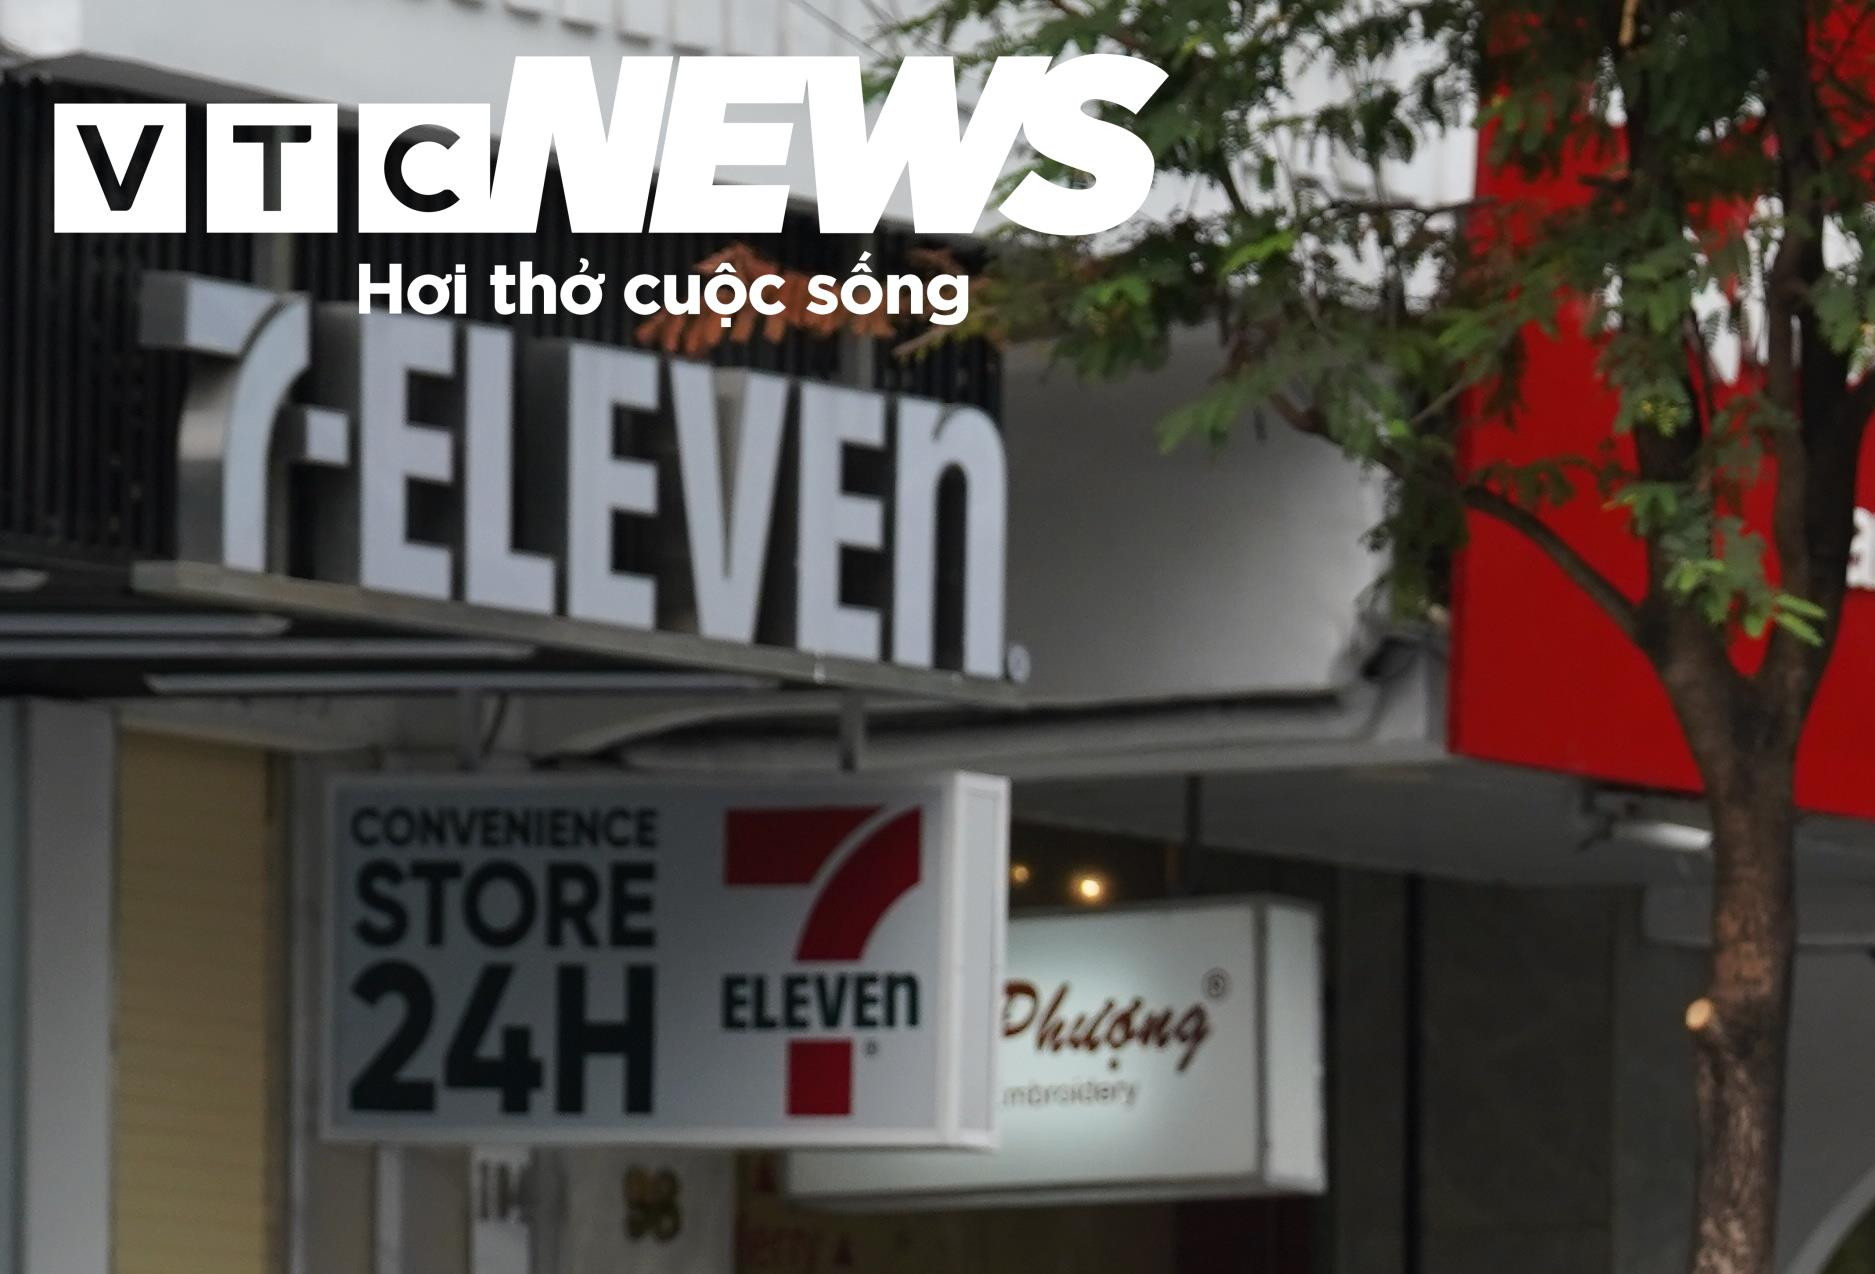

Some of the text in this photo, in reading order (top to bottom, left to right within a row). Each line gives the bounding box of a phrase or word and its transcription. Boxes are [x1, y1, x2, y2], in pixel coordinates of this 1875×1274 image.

[350, 806, 659, 849] CONVENIENCE
[353, 860, 658, 948] STORE
[348, 960, 657, 1116] 24H
[1003, 1080, 1140, 1108] mbroidery
